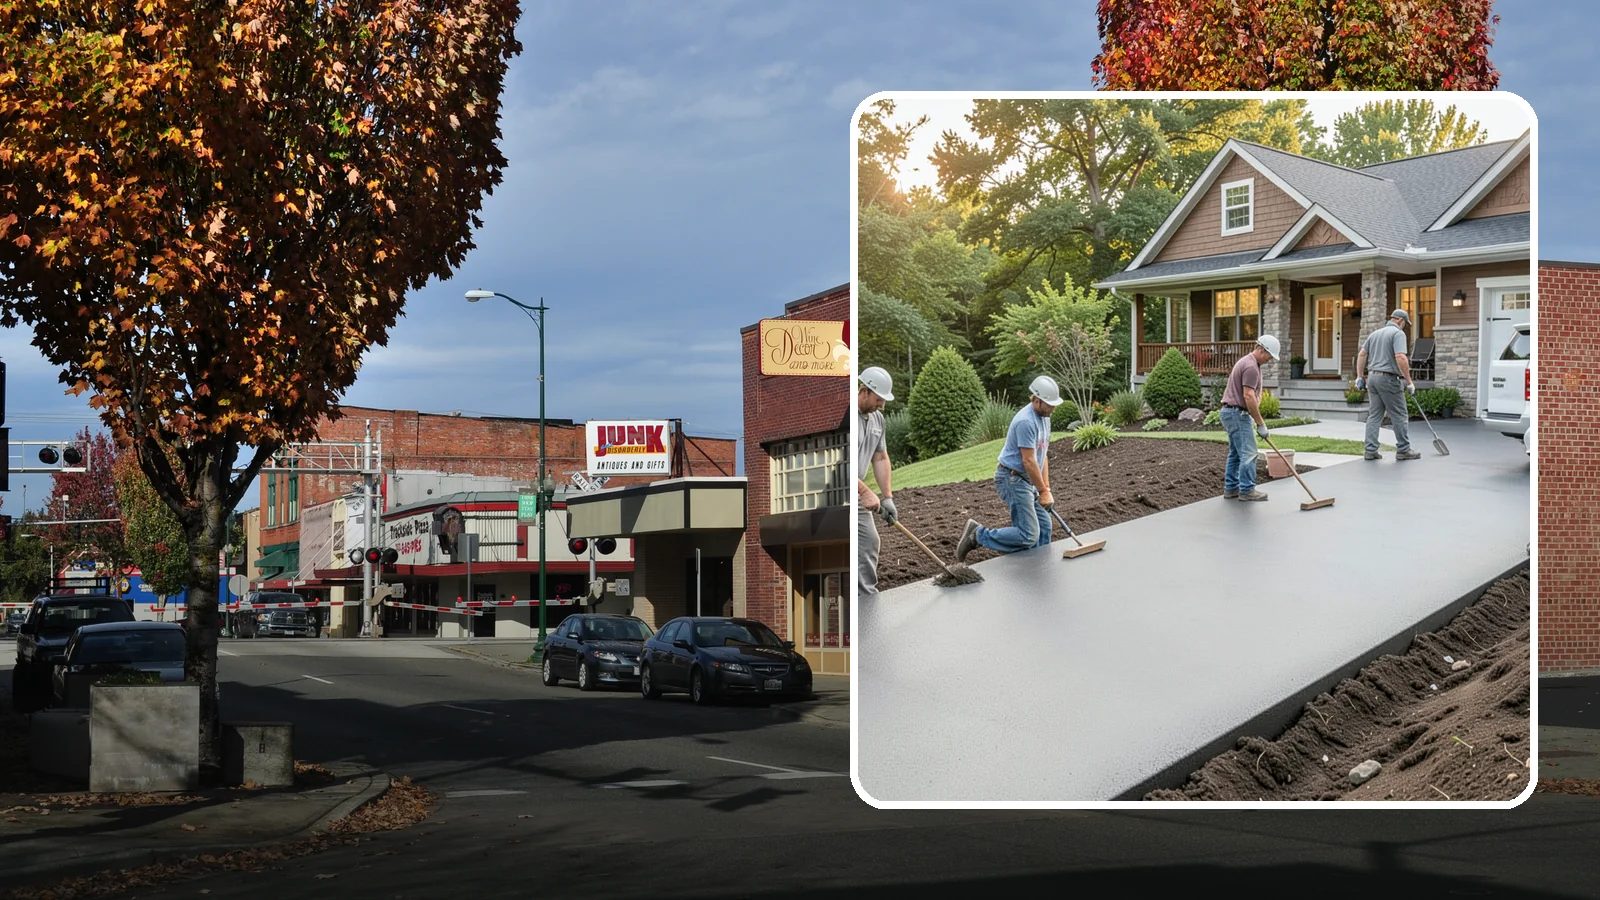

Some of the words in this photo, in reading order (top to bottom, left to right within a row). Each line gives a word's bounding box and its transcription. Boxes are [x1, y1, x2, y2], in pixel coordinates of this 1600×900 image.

[595, 425, 665, 457] JUNK
[607, 446, 646, 454] DISORDERLY
[597, 461, 628, 470] ANTIQUES
[631, 461, 644, 470] AND
[647, 460, 665, 469] GIFTS
[390, 521, 413, 539] Trackside
[414, 519, 429, 535] Pizza
